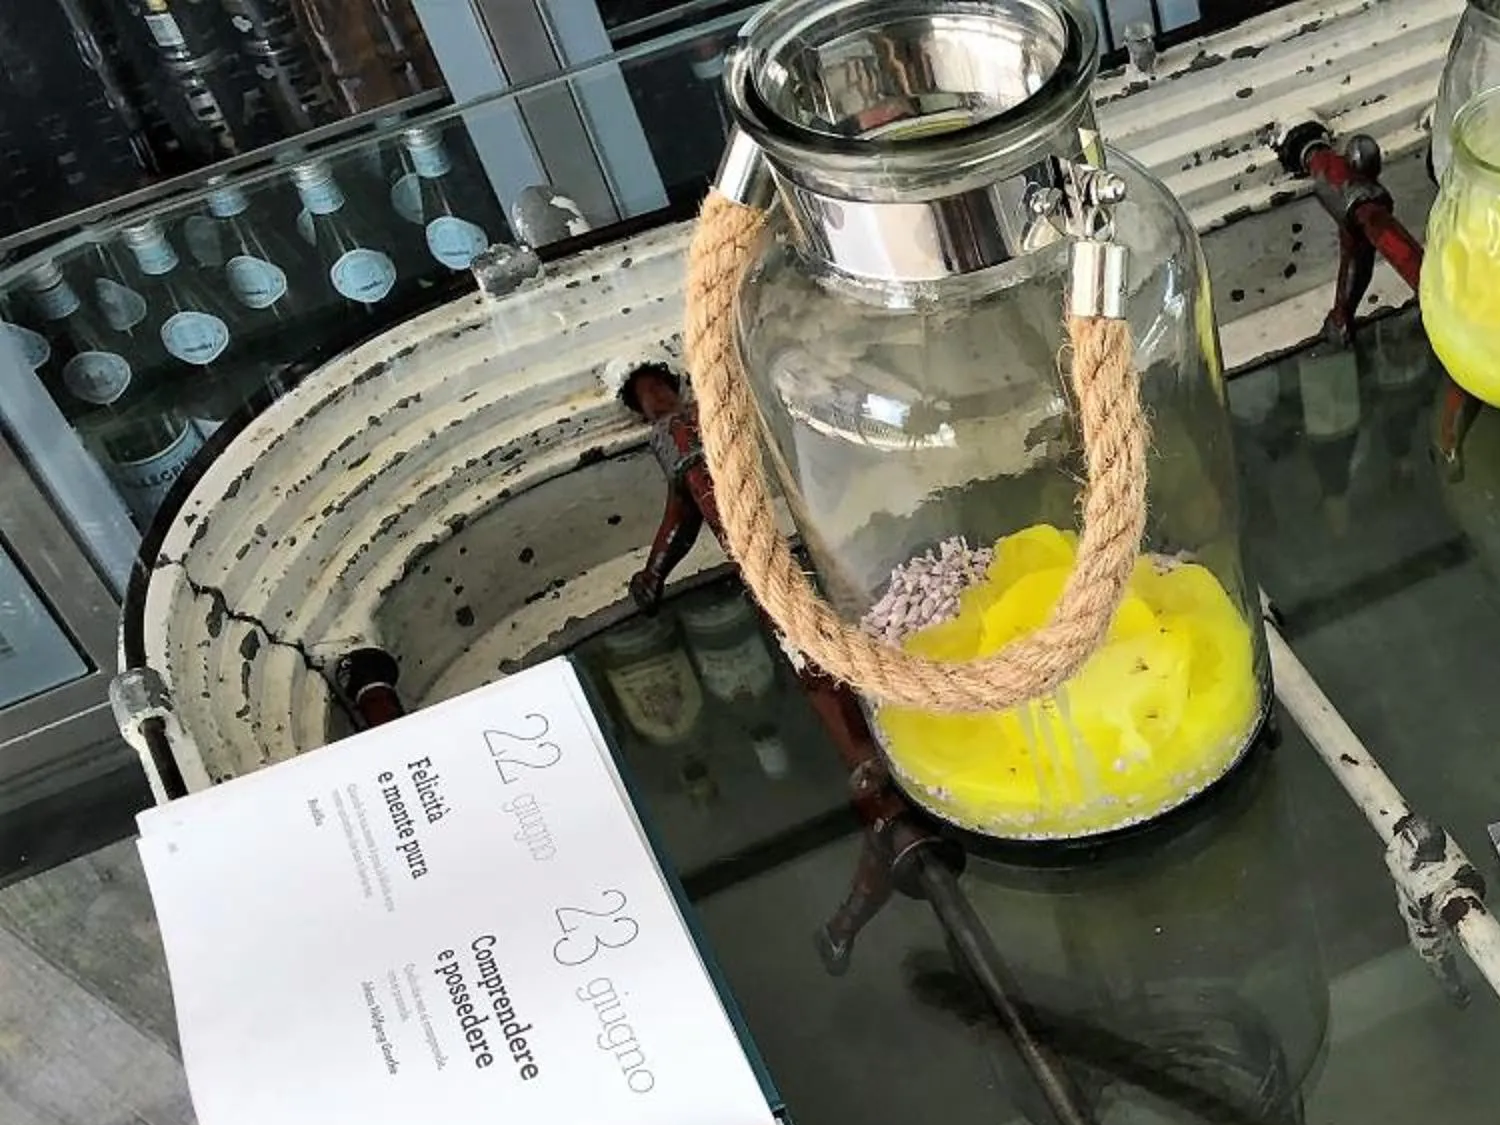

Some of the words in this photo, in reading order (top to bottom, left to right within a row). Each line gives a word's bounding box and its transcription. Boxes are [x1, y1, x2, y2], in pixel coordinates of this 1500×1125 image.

[378, 771, 394, 784] e
[482, 713, 563, 785] 22
[382, 784, 415, 840] mente
[407, 756, 451, 824] Felicità
[395, 839, 428, 880] pura
[502, 792, 558, 862] giugno
[437, 949, 455, 963] e
[551, 888, 640, 967] 23
[434, 961, 494, 1069] possedere
[471, 935, 539, 1080] Comprendere
[576, 977, 656, 1095] giugno
